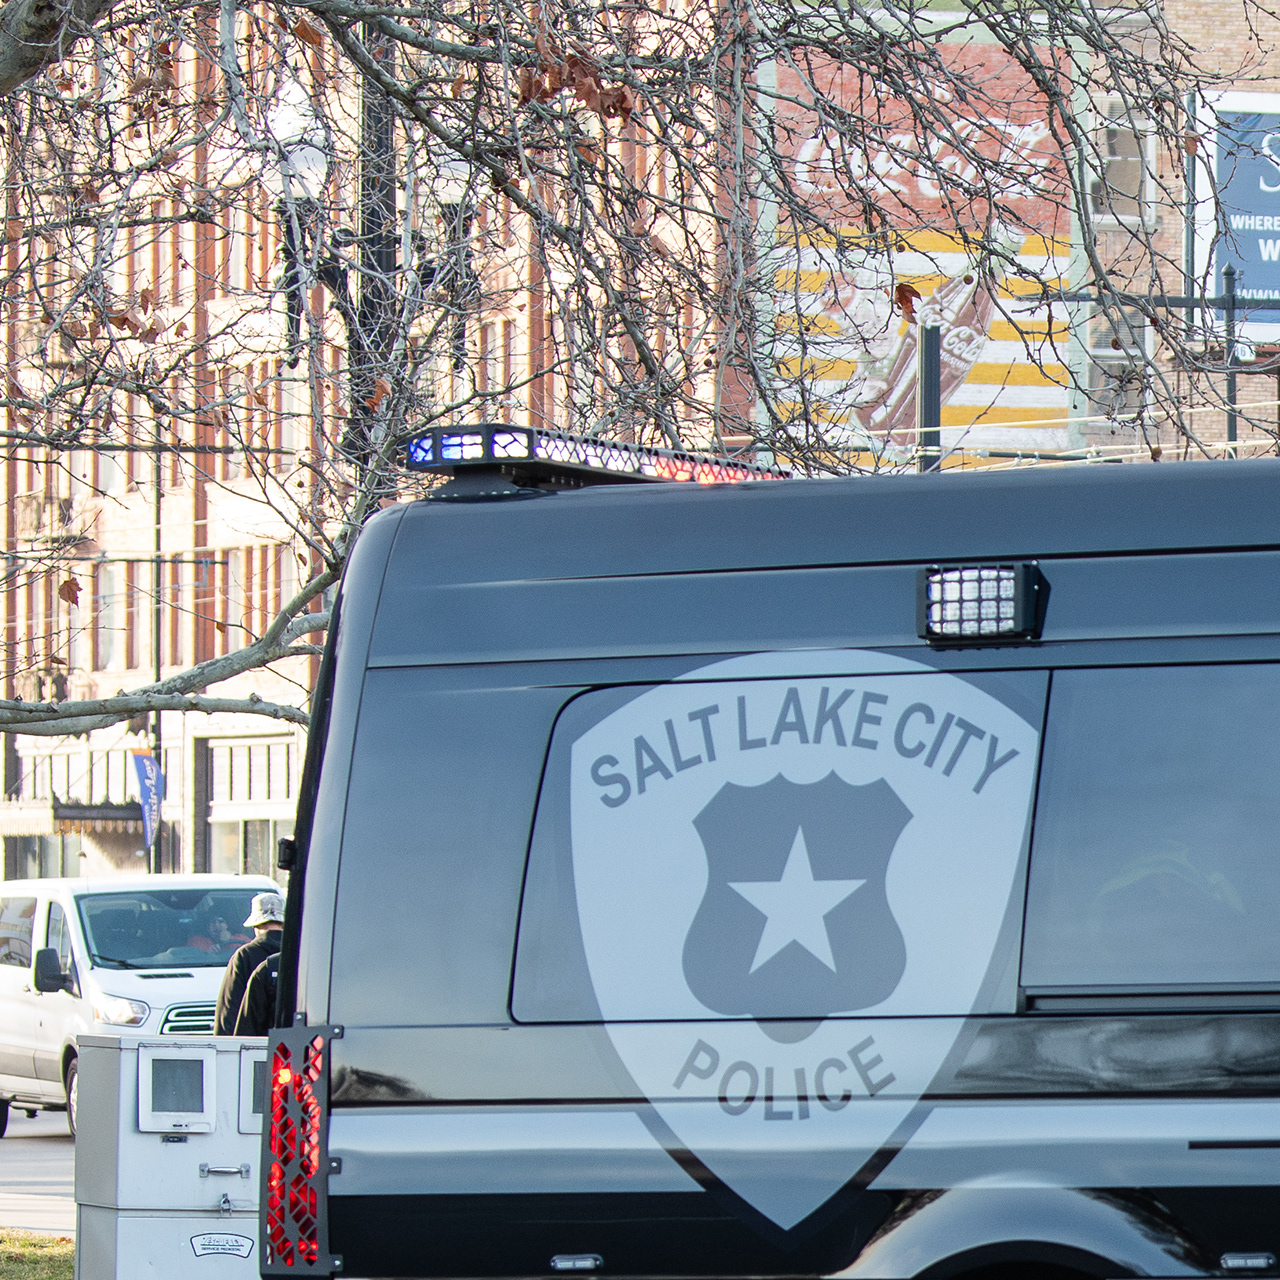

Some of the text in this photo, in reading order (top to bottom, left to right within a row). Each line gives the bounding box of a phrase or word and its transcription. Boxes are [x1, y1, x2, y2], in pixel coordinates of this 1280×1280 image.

[589, 686, 1020, 808] SALT LAKE CITY
[672, 1035, 898, 1122] POLICE
